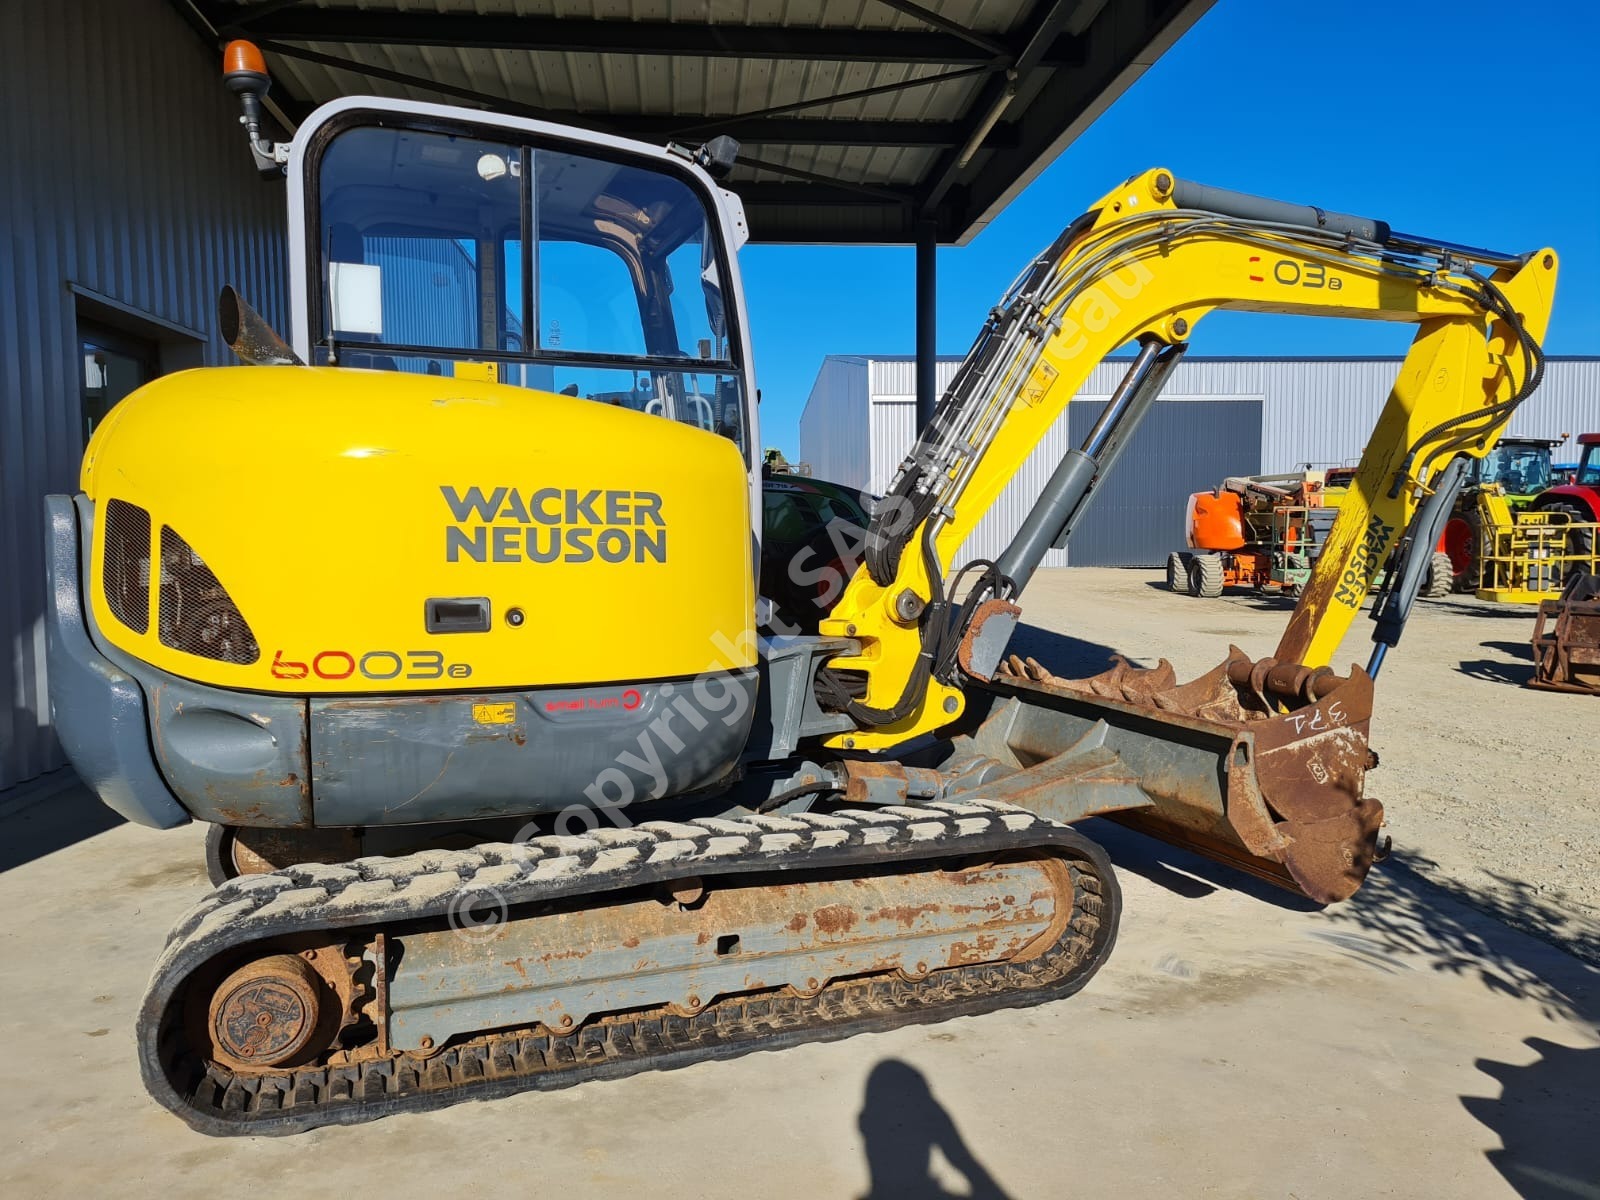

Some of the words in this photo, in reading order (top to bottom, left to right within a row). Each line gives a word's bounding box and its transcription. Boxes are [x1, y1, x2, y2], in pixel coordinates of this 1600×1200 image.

[439, 485, 668, 526] WACKER
[445, 525, 667, 564] NEUSON
[1334, 513, 1385, 604] NEUSON
[1344, 525, 1395, 609] WACKER
